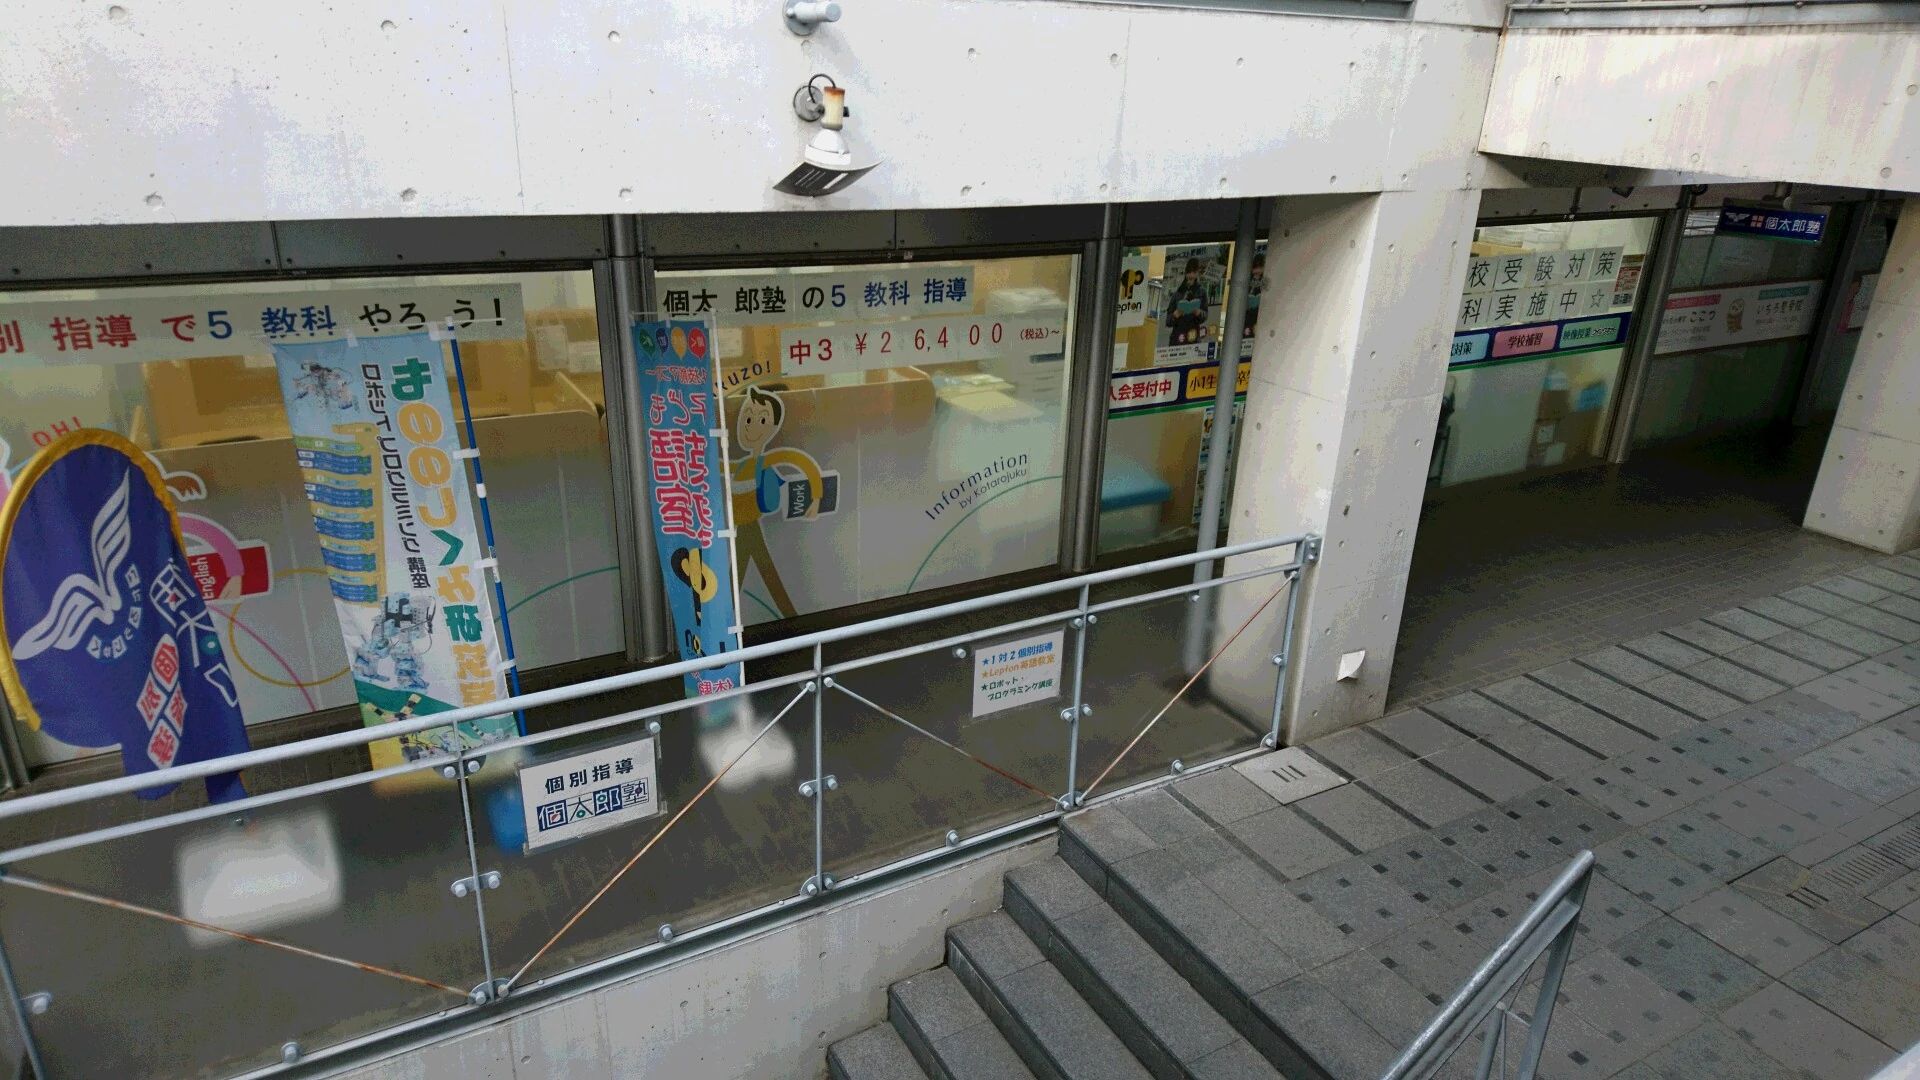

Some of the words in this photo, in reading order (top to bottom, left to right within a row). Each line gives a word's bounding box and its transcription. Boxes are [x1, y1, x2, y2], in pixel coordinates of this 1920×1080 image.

[1765, 216, 1822, 235] 個太郎塾
[1468, 252, 1617, 288] 校受験対策
[1115, 300, 1142, 313] epton
[792, 484, 806, 515] Work
[925, 453, 1027, 520] Information
[959, 497, 972, 509] by
[974, 468, 1027, 498] Kotarojuku
[200, 555, 216, 600] English
[545, 758, 633, 794] 個別指導
[537, 778, 649, 832] 個太郎塾
